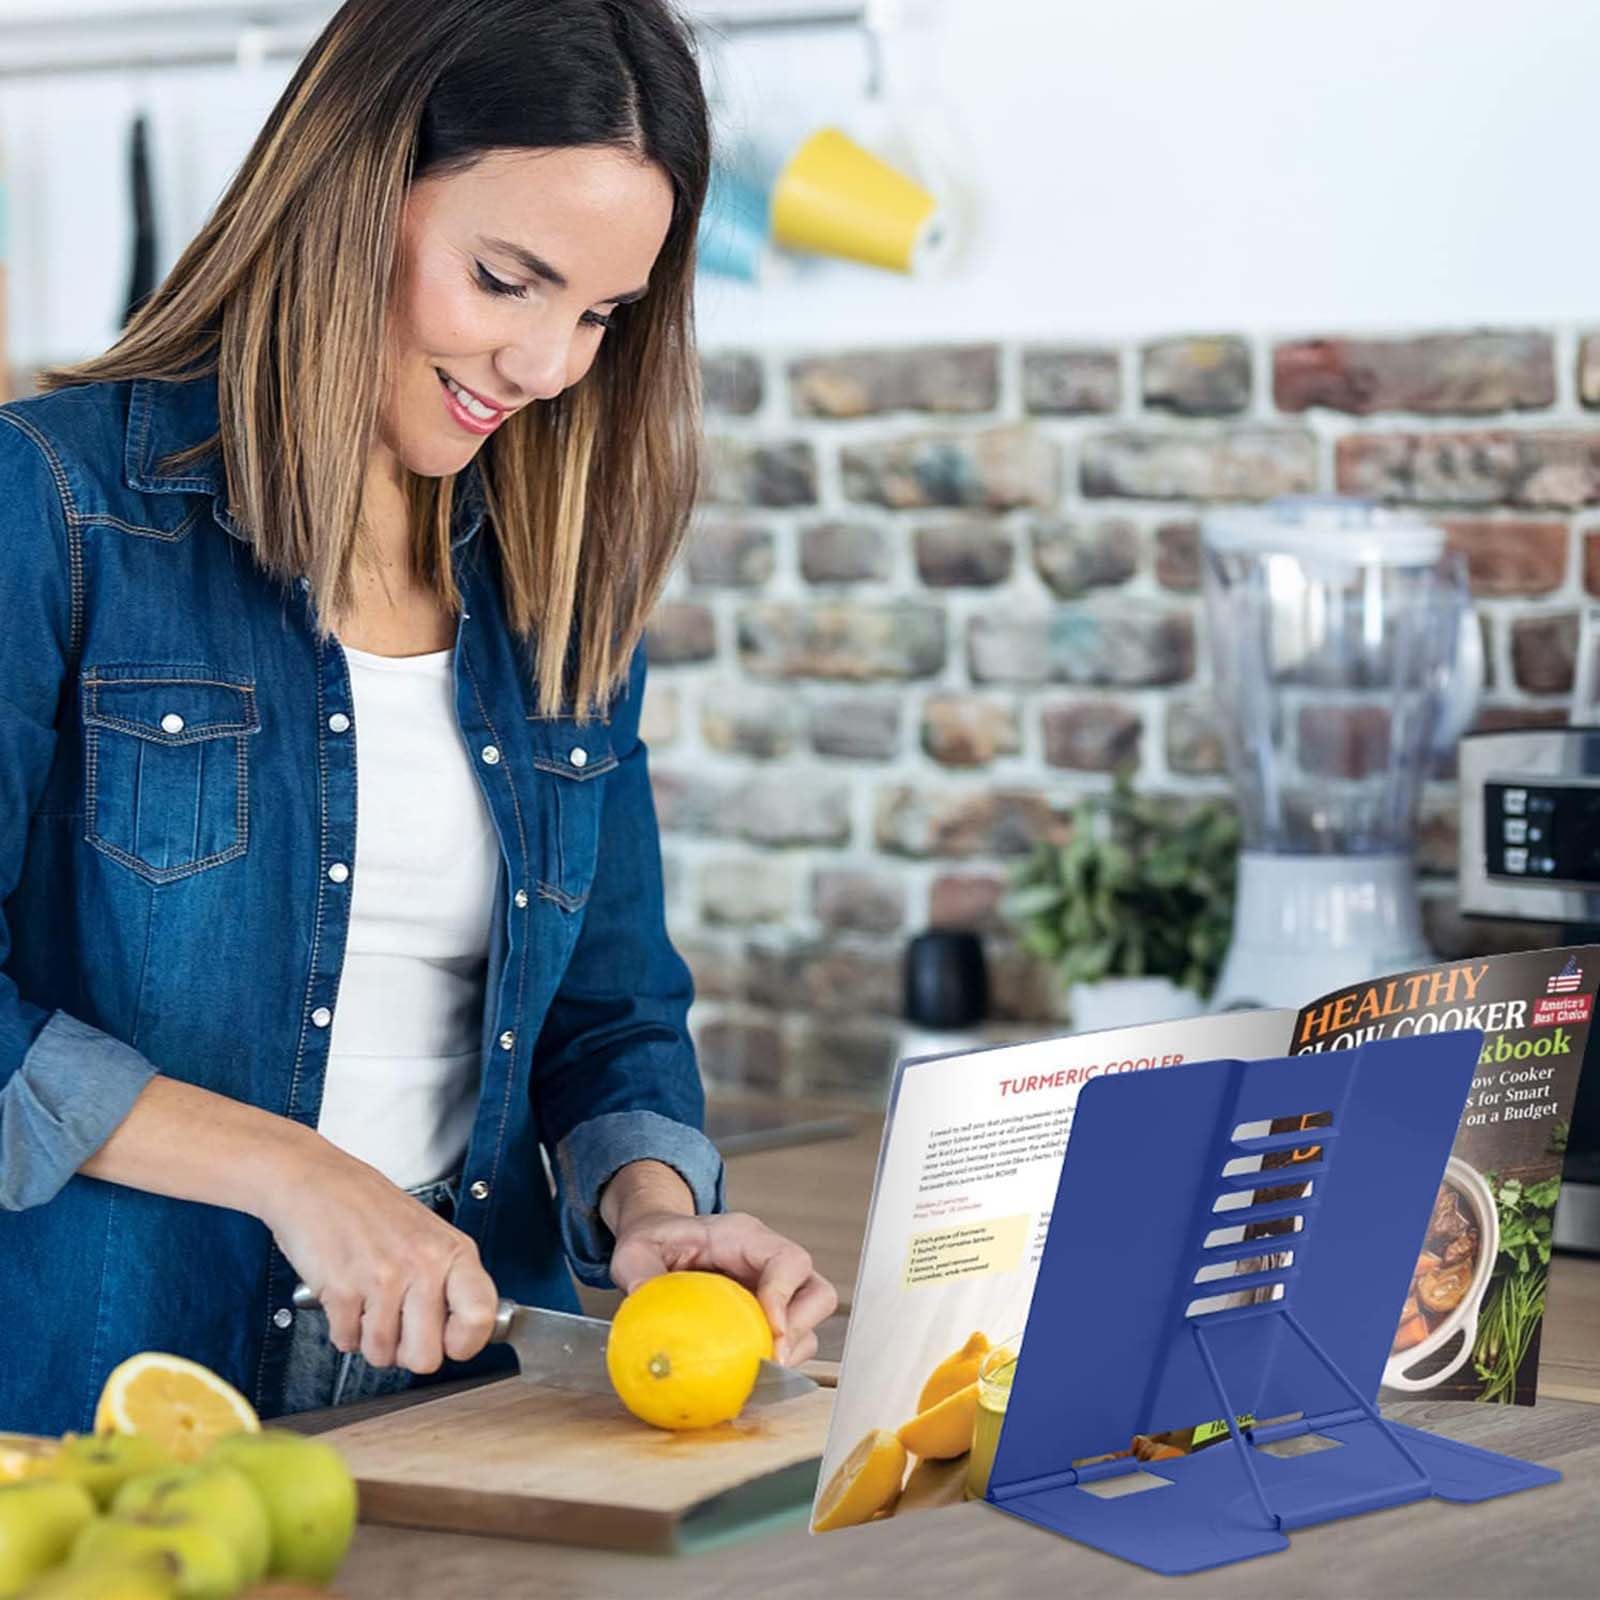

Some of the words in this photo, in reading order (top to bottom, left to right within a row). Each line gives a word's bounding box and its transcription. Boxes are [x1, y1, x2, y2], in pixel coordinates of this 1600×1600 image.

[1300, 964, 1489, 1043] HEALTHY
[1534, 1012, 1555, 1024] Best
[1557, 1009, 1588, 1021] Choice
[1392, 1000, 1527, 1038] COOKER
[1478, 1027, 1572, 1064] kbook
[999, 1064, 1099, 1096] TURMERIC
[1499, 1066, 1555, 1085] Cooker
[1478, 1091, 1501, 1106] for
[1504, 1085, 1550, 1102] Smart
[1466, 1112, 1487, 1126] on
[1490, 1111, 1499, 1122] a
[1504, 1102, 1558, 1120] Budget
